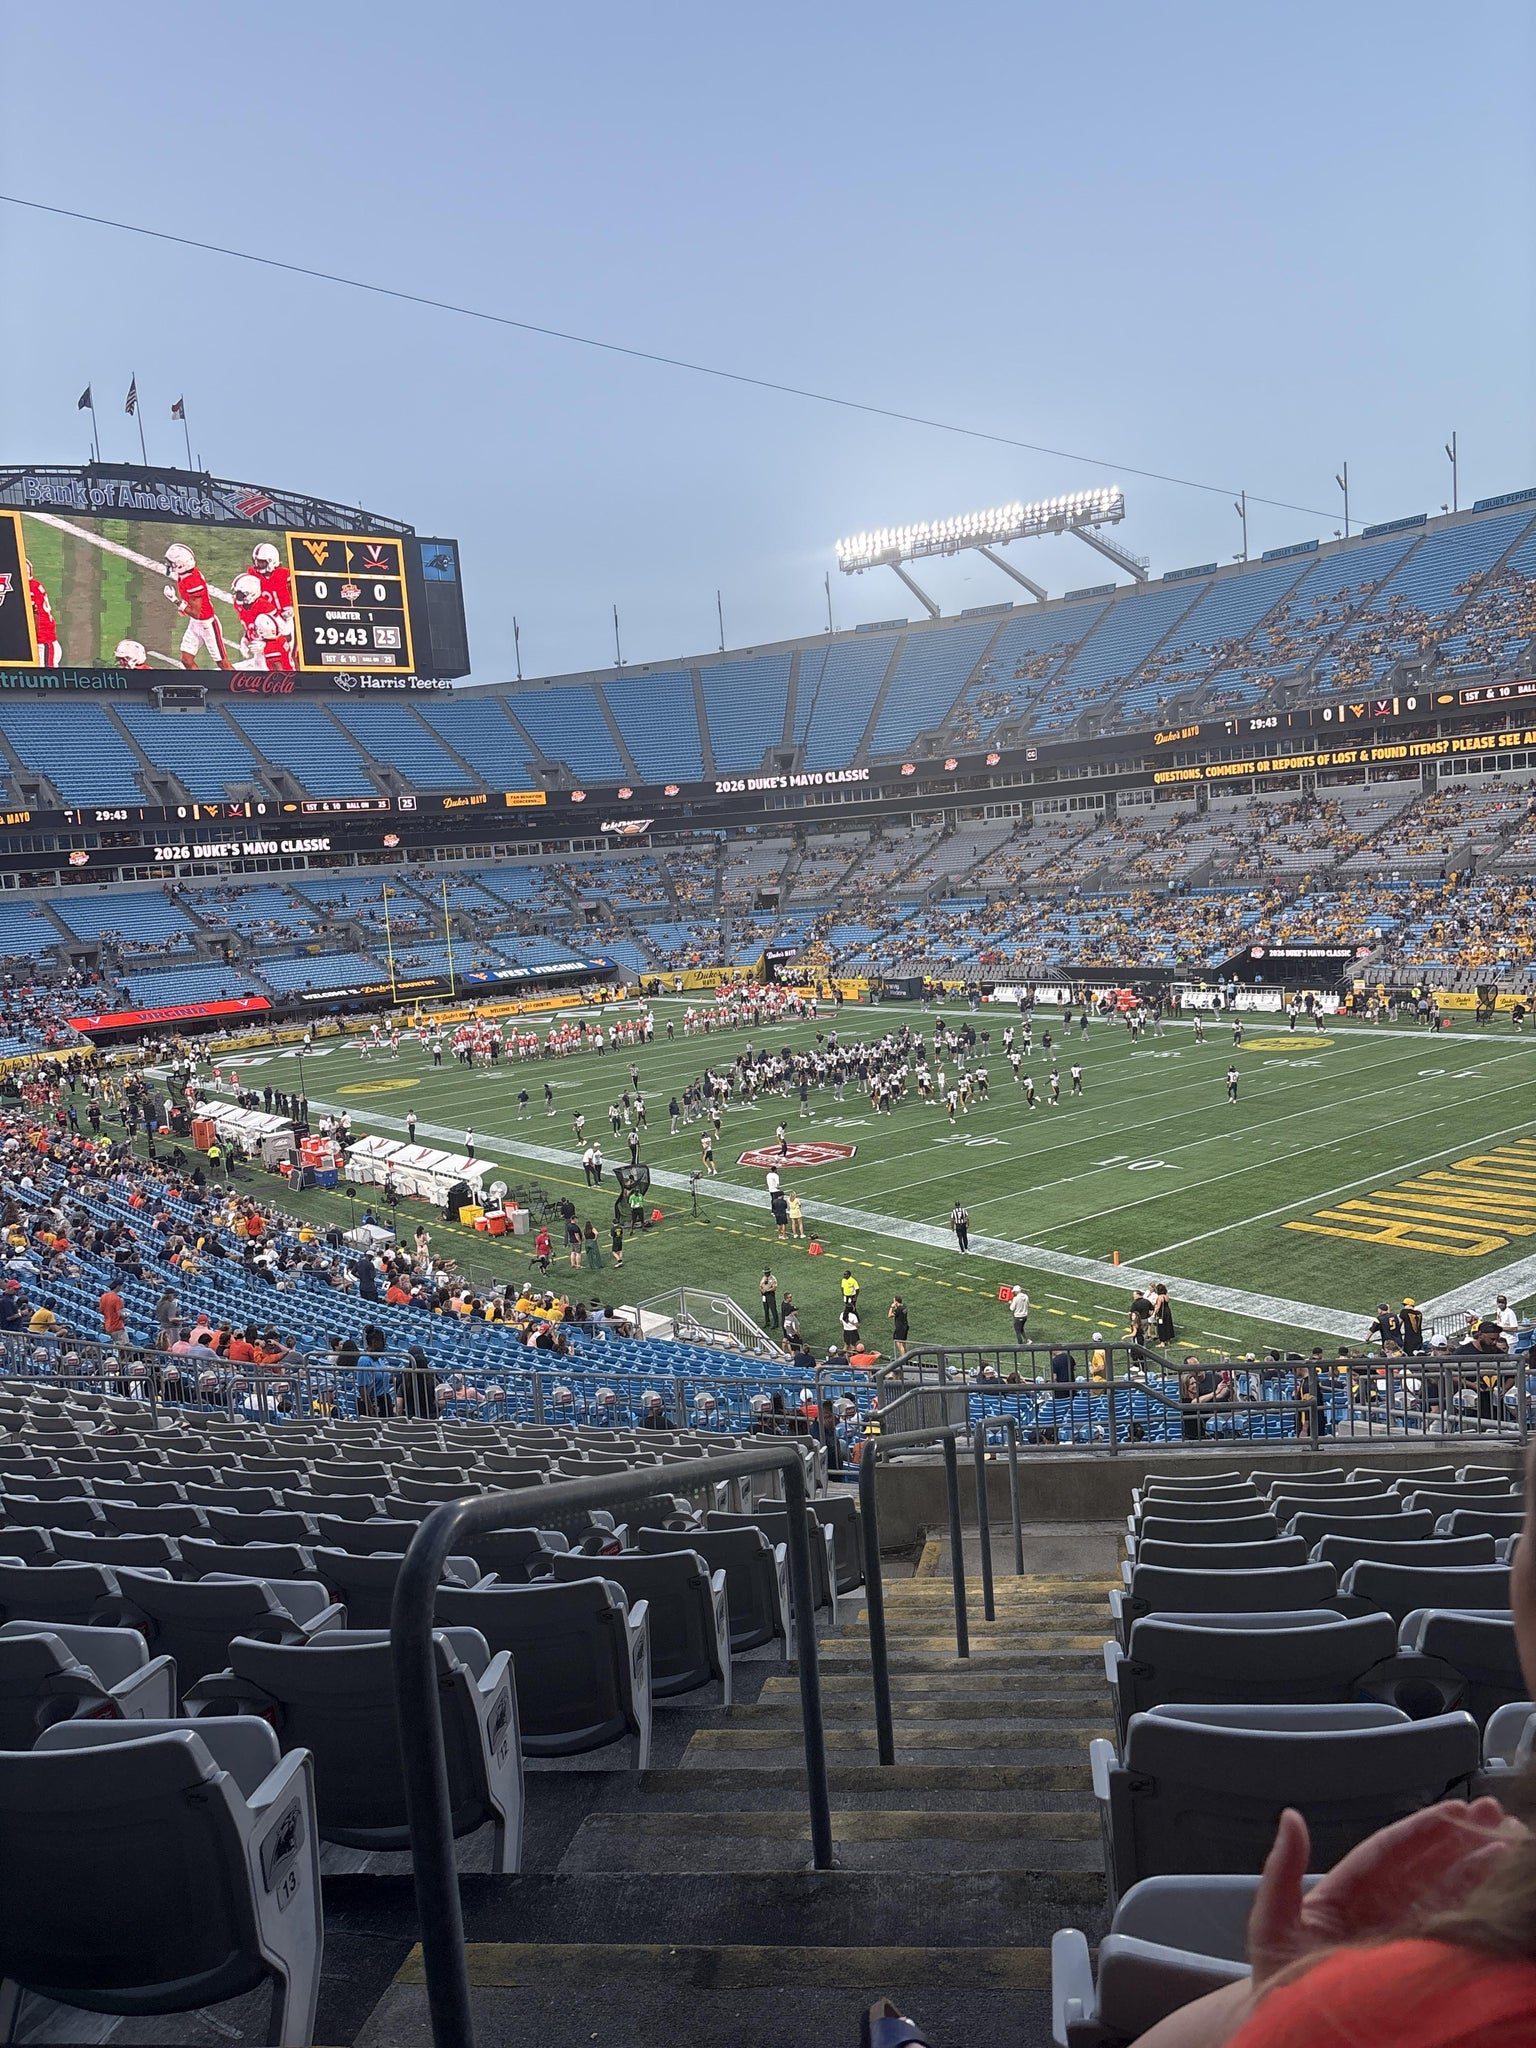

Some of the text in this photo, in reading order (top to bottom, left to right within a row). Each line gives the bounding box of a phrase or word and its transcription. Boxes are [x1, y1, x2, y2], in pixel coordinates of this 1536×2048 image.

[22, 476, 214, 515] Bank of America
[315, 581, 328, 599] 0
[374, 584, 387, 601] 0
[325, 611, 374, 621] QUARTER 1
[314, 628, 368, 645] 29:43
[376, 629, 396, 644] 25
[325, 655, 357, 663] 1ST & 10
[0, 670, 128, 689] trium Health
[360, 676, 452, 690] Harris Teeter
[1465, 684, 1536, 701] 1ST & 10 BALL
[1406, 697, 1417, 710] 0
[1323, 708, 1332, 721] 0
[1250, 716, 1278, 730] 29:43
[1182, 725, 1199, 740] MAYO
[1154, 767, 1203, 784] QUESTIONS,
[1206, 760, 1255, 777] COMMENTS
[1257, 758, 1270, 772] OR
[1272, 752, 1315, 770] REPORTS
[1317, 749, 1330, 764] OF
[1332, 747, 1357, 764] LOST
[1360, 745, 1369, 762] &
[1371, 740, 1407, 759] FOUND
[1409, 735, 1449, 756] ITEMS?
[1452, 735, 1496, 752] PLEASE
[1498, 733, 1521, 747] SEE
[715, 768, 869, 793] 2026 DUKE'S MAYO CLASSIC
[402, 799, 413, 808] 25
[470, 794, 487, 805] MAYO
[177, 806, 187, 819] 0
[257, 803, 267, 815] 0
[306, 804, 317, 812] 1ST
[333, 803, 341, 811] 10
[6, 811, 31, 824] MAYO
[95, 810, 128, 821] 29:43
[154, 838, 331, 861] 2026 DUKE'S MAYO CLASSIC
[494, 962, 587, 978] WEST VIRGINIA
[136, 1007, 209, 1022] VIRGINIA
[1001, 1287, 1011, 1300] G
[283, 1871, 296, 1898] 13
